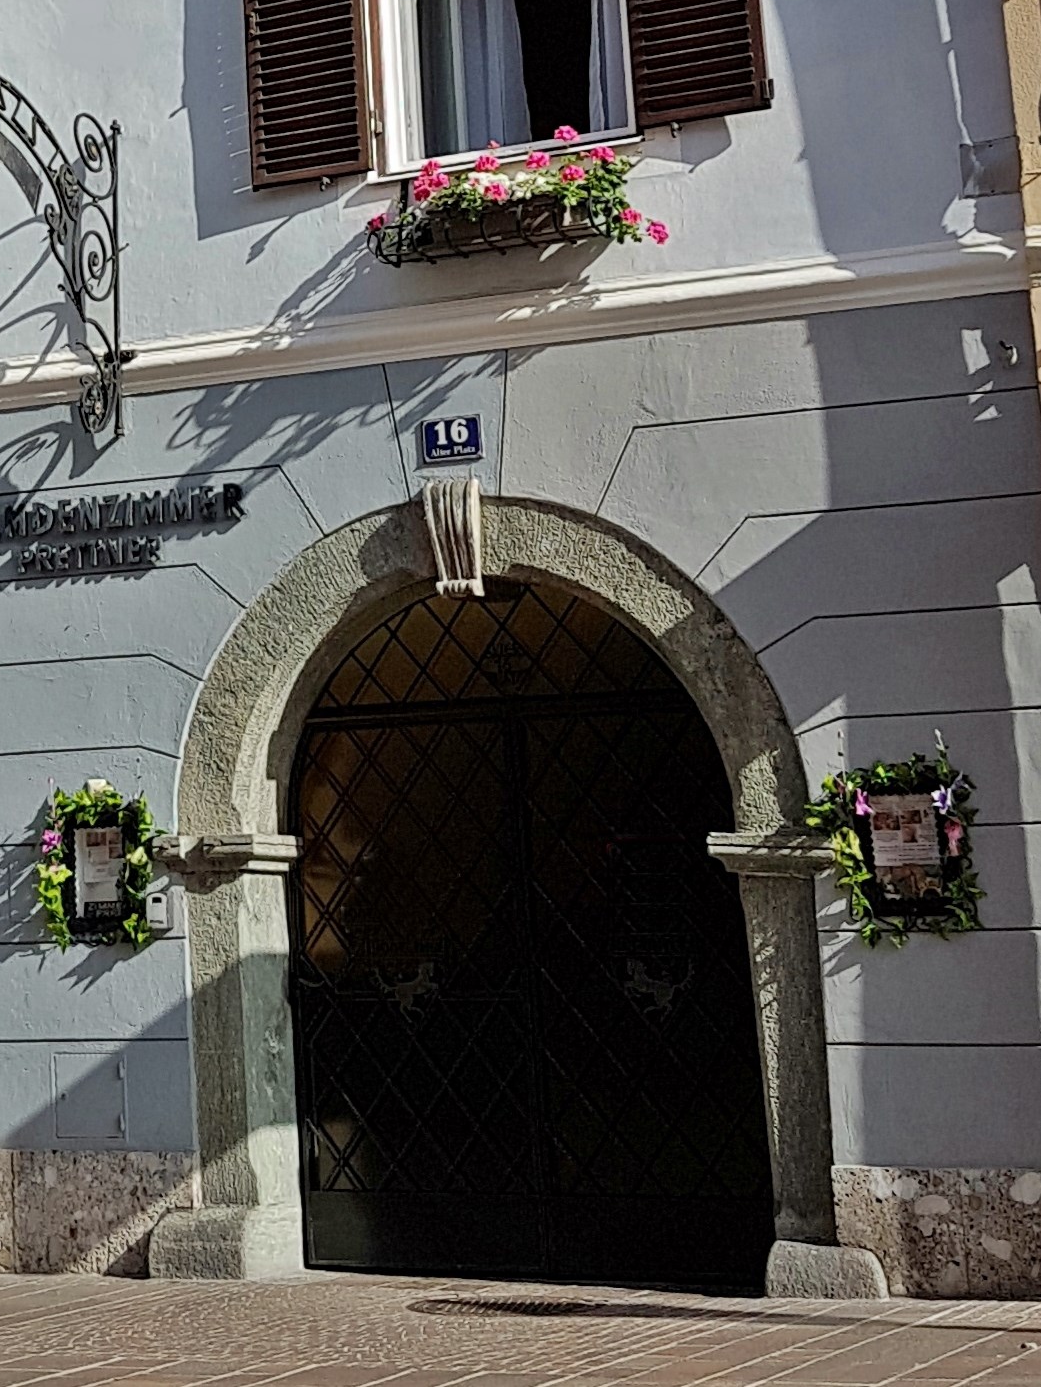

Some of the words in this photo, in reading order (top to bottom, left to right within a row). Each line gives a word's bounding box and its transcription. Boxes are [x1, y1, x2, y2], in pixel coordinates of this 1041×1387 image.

[434, 418, 469, 445] 16
[431, 447, 452, 457] Alter
[453, 445, 476, 455] Platz
